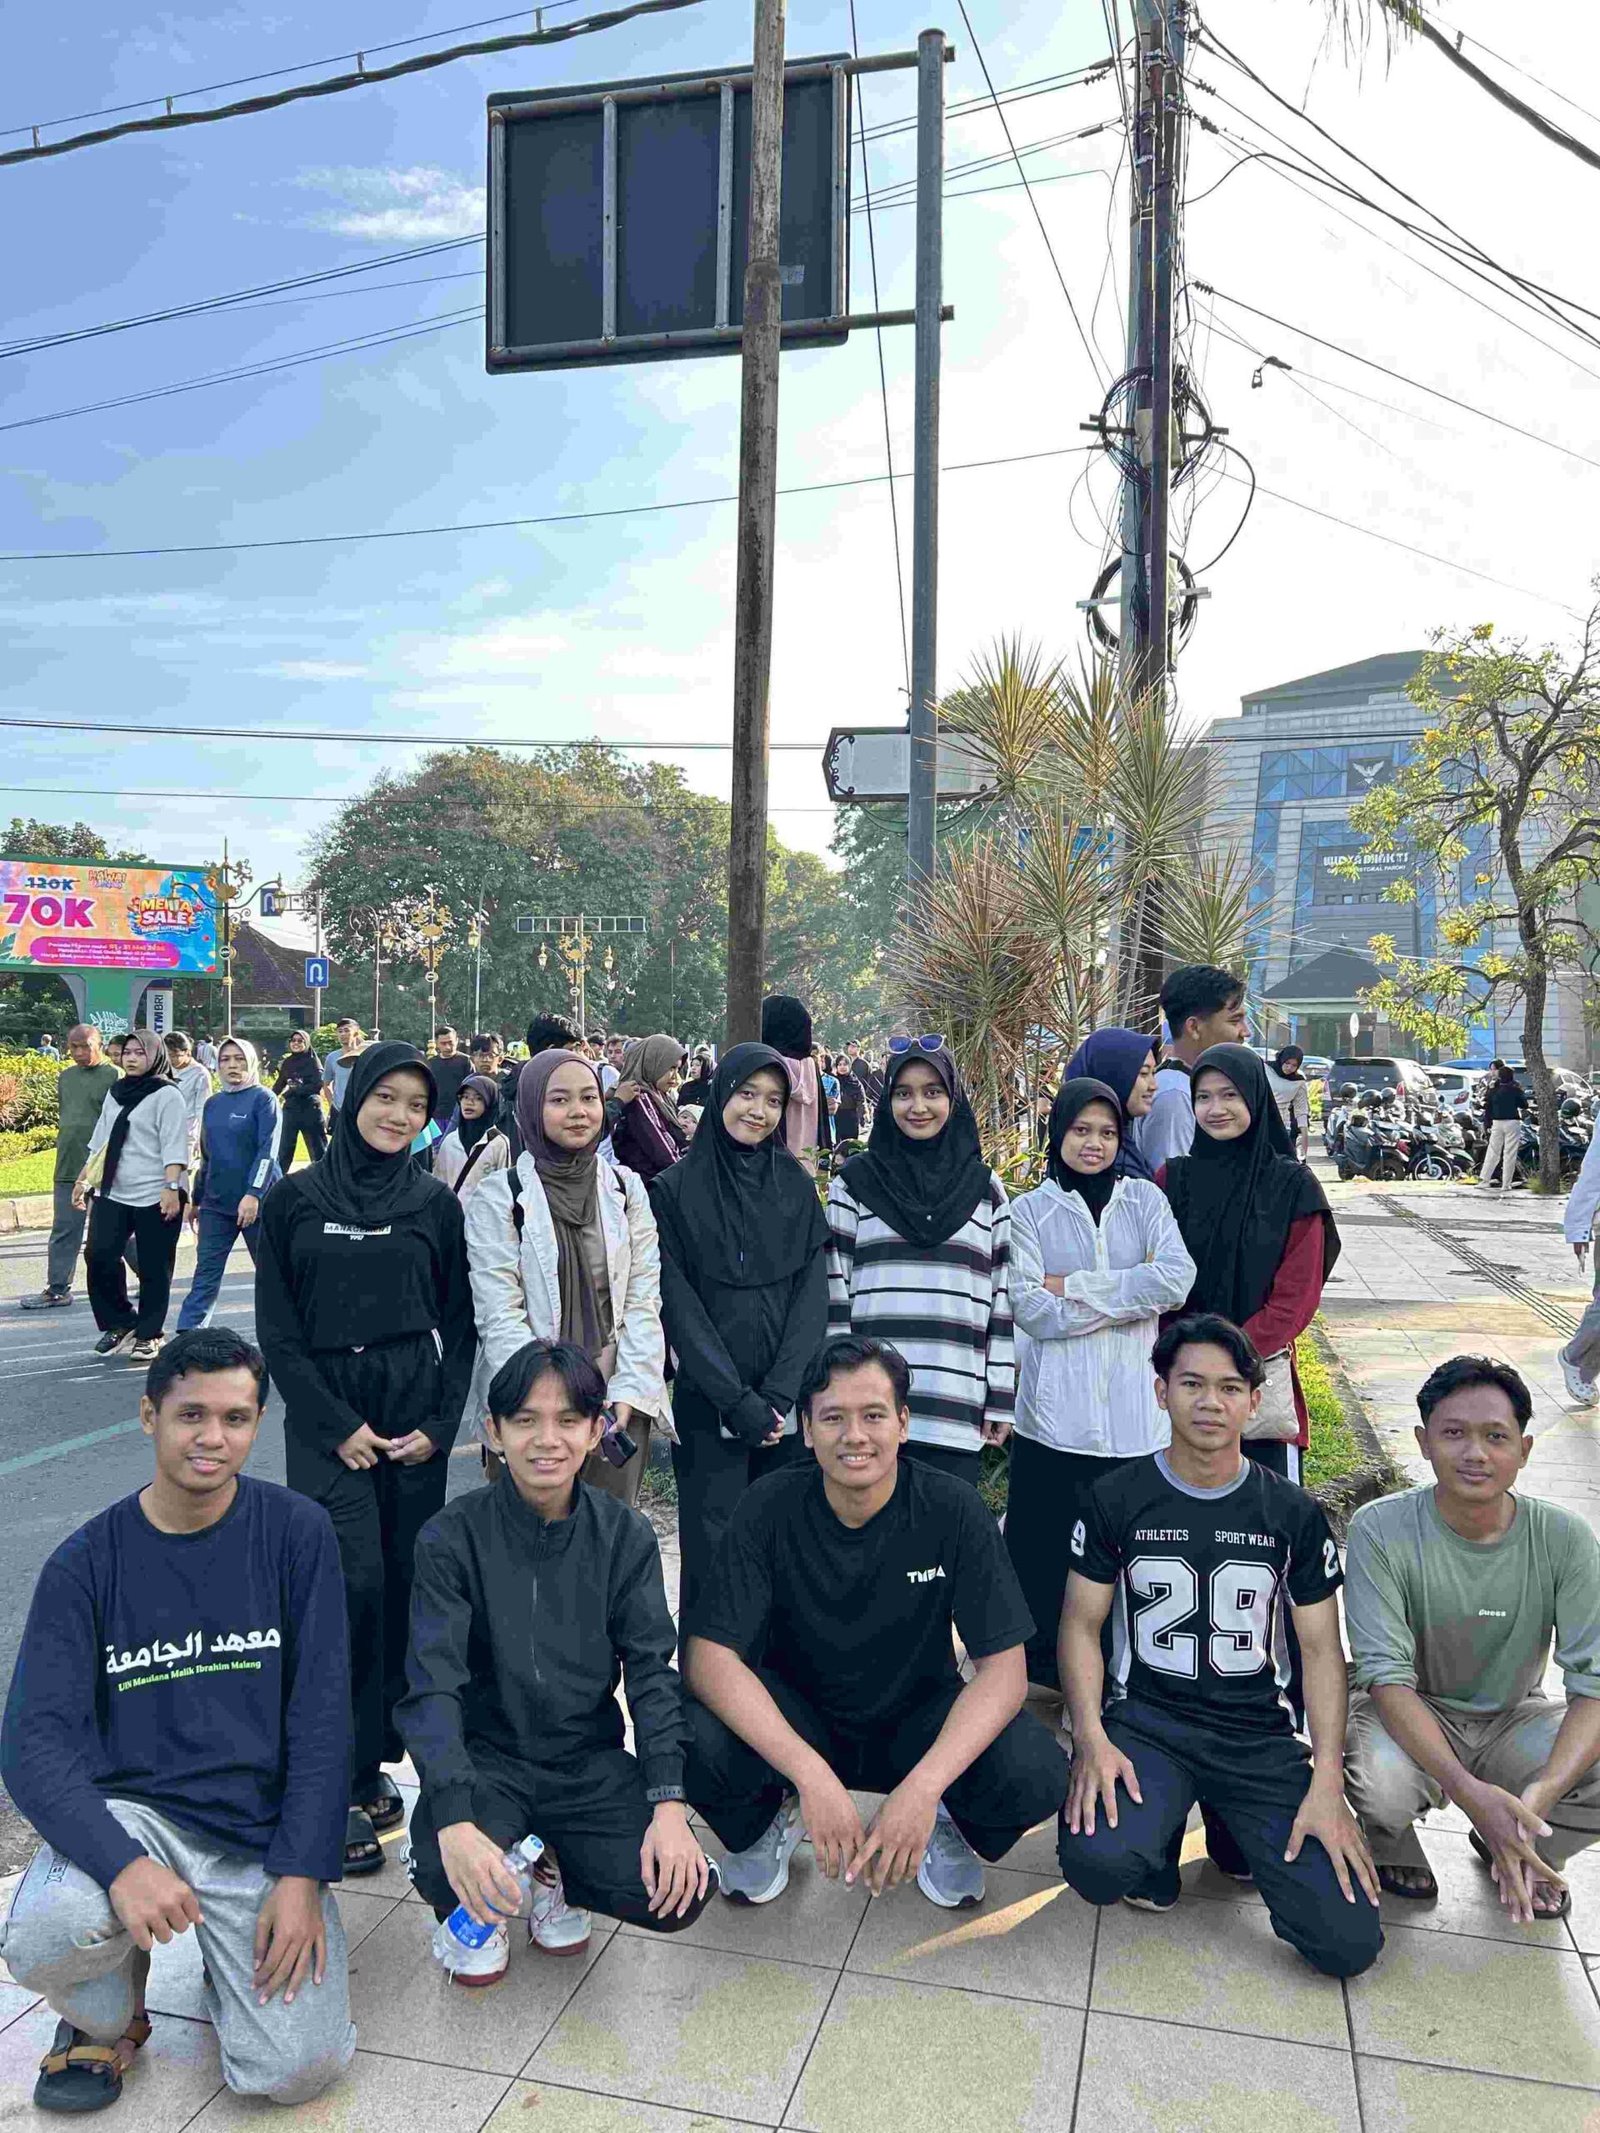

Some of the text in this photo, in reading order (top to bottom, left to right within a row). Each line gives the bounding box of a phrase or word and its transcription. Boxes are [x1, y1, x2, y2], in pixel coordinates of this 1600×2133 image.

[27, 877, 74, 891] 120K
[3, 893, 96, 928] 70K
[140, 898, 192, 911] MEA
[142, 911, 188, 924] SALE
[154, 994, 164, 1011] BRI
[1071, 1519, 1086, 1556] 9
[1134, 1529, 1189, 1541] ATHLETICS
[1215, 1530, 1276, 1548] SPORT WEAR
[1323, 1538, 1339, 1579] 2
[1127, 1555, 1278, 1680] 29
[105, 1628, 281, 1674] معهد الجامعة
[118, 1660, 262, 1692] UIN Maulana Malik Ibrahim Malang
